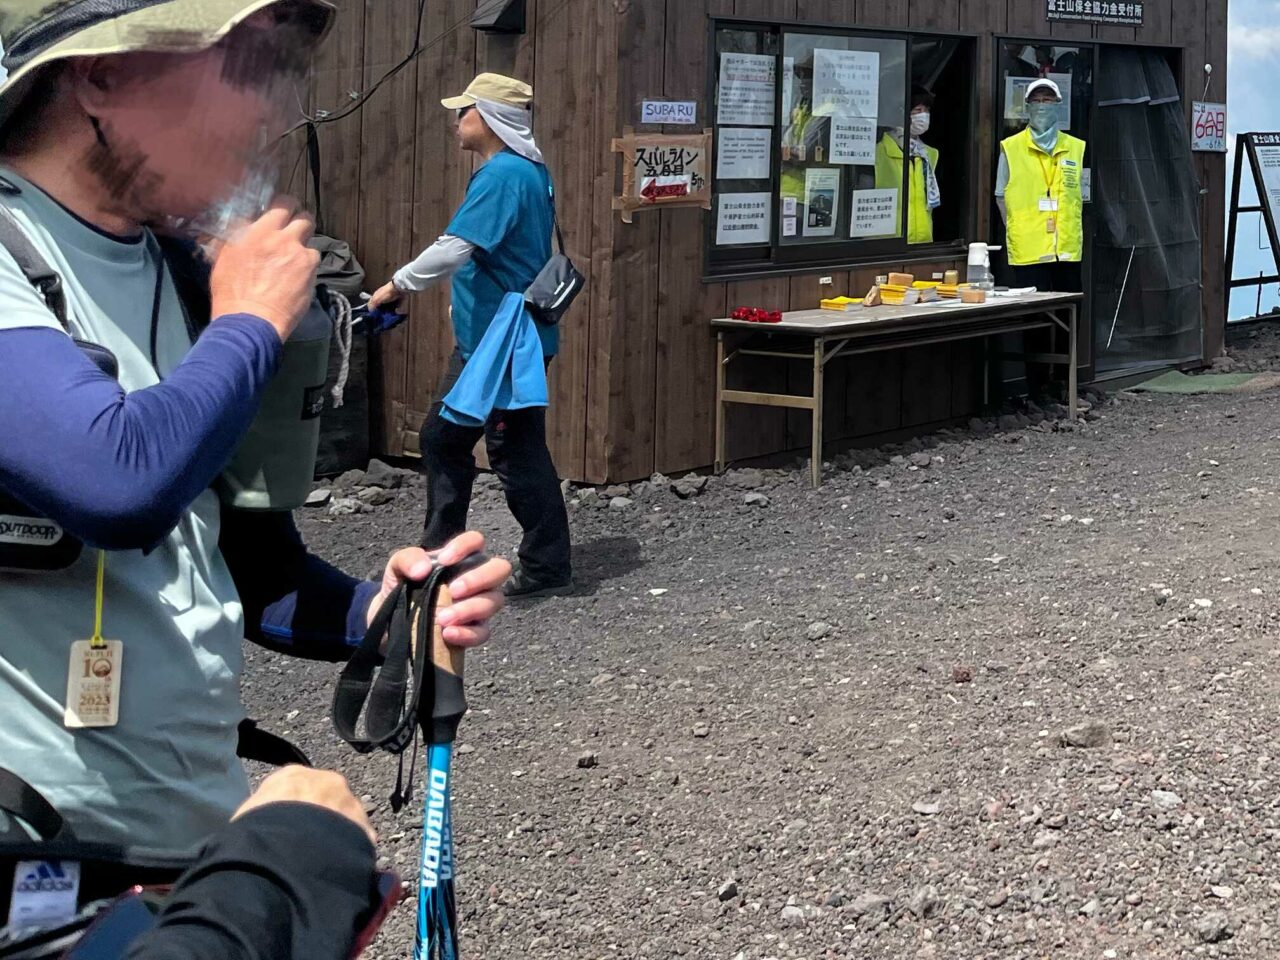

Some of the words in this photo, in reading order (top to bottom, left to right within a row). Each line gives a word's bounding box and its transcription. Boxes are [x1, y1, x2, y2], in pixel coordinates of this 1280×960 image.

[645, 103, 694, 116] SUBARU
[1195, 111, 1225, 139] 6合目
[634, 146, 699, 167] スバルライン
[421, 768, 447, 888] DABADA
[16, 880, 74, 893] adidas
